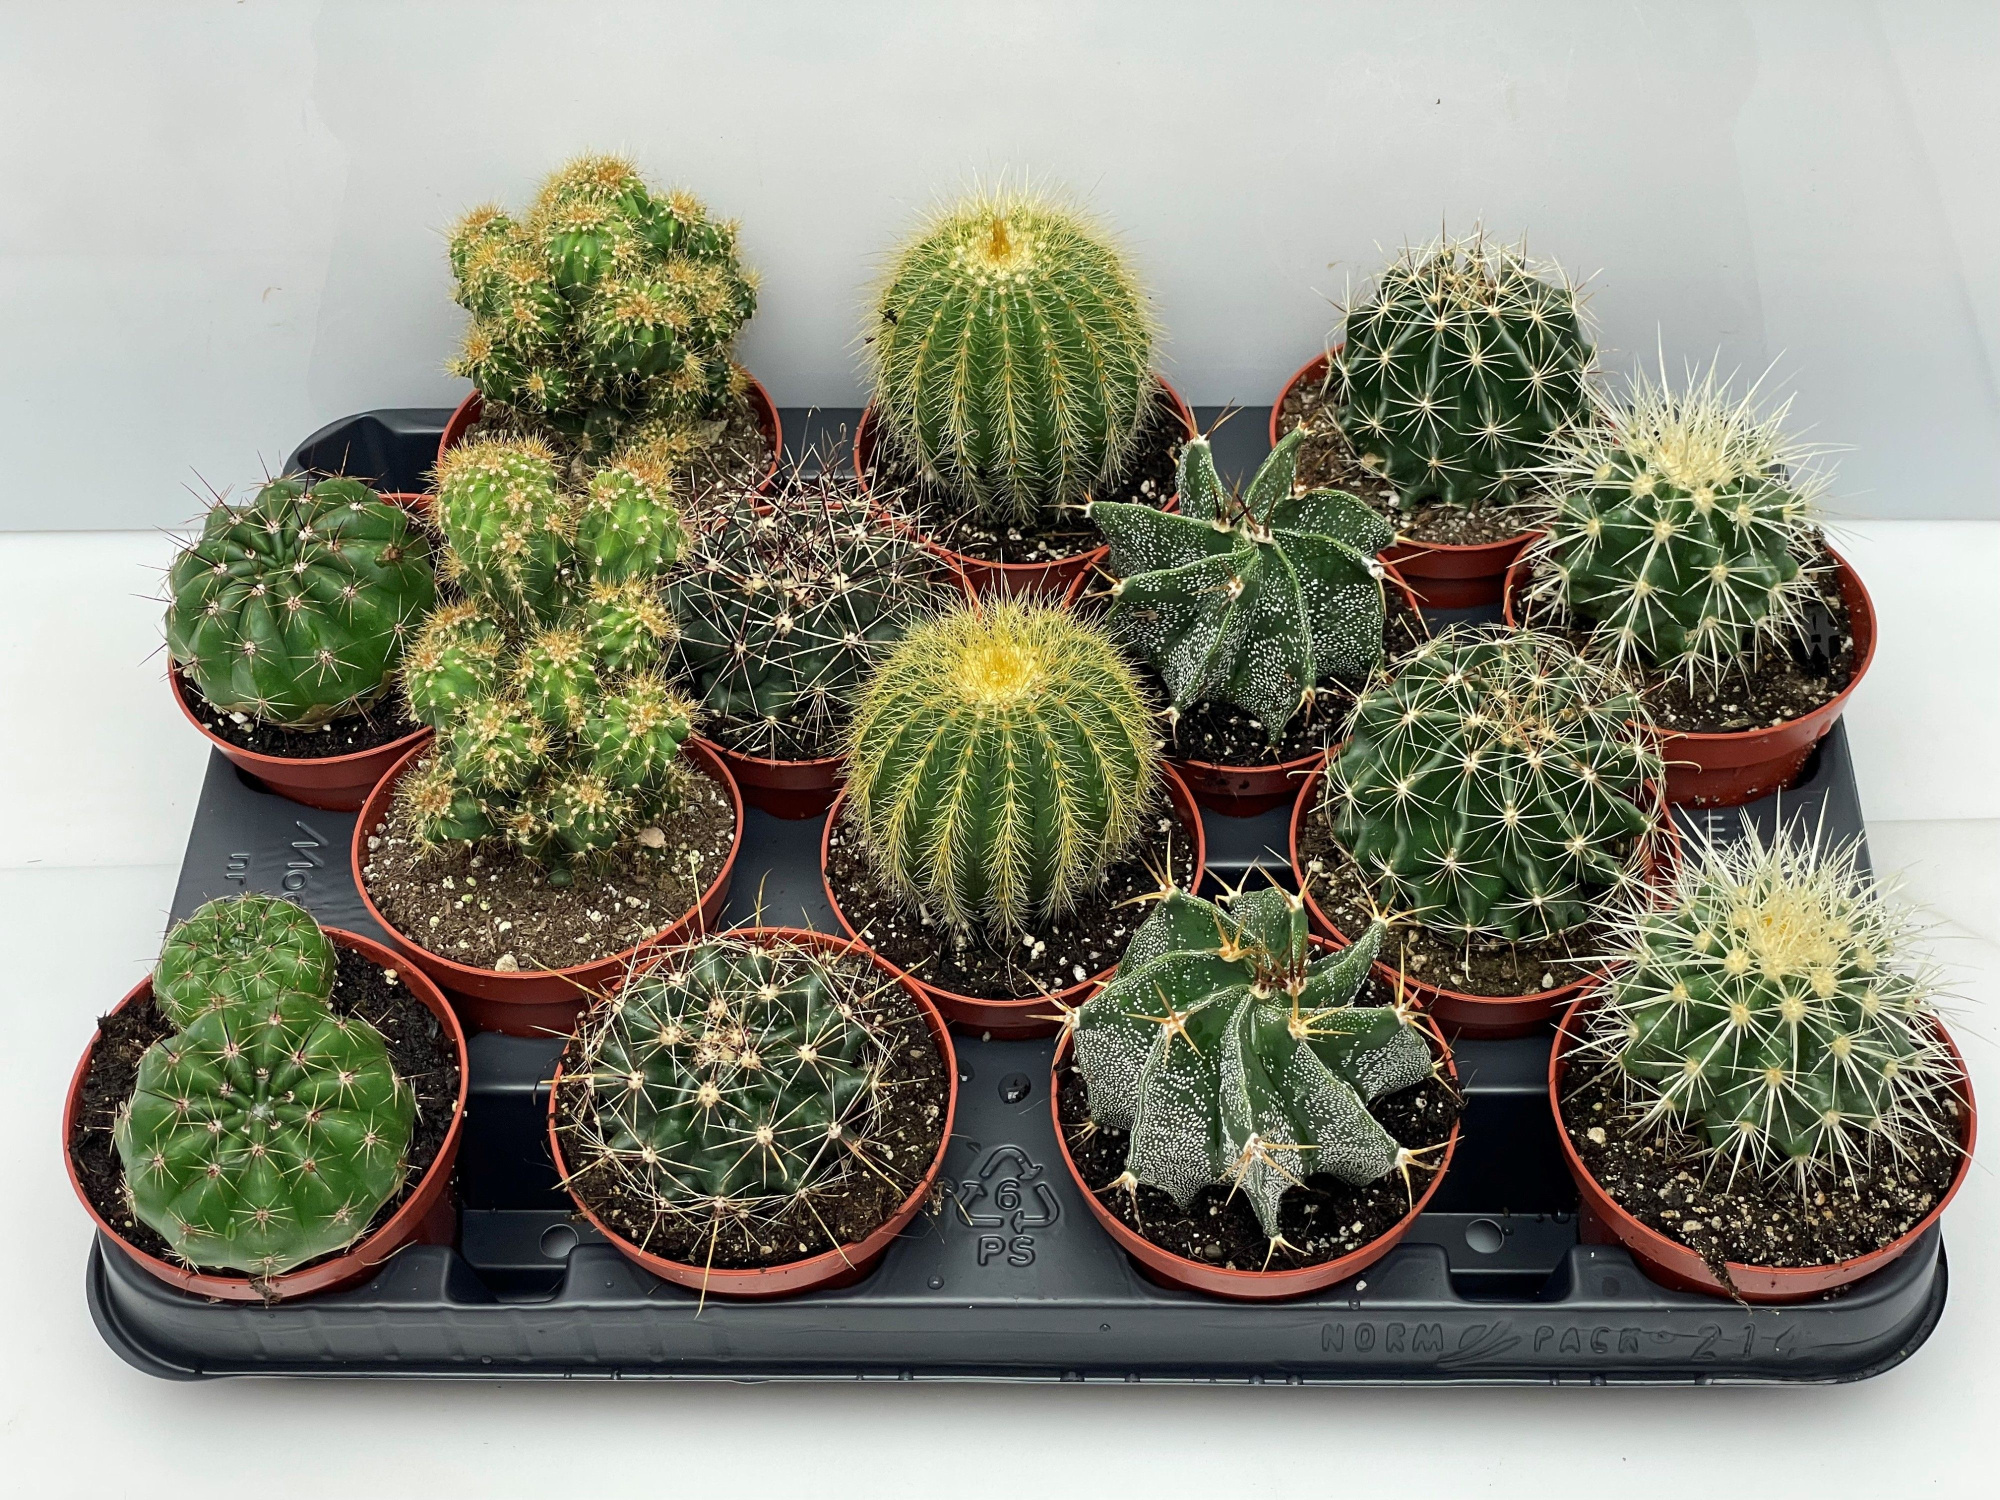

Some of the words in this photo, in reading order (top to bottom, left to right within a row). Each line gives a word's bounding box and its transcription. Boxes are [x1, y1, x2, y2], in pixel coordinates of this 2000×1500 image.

[995, 1177, 1021, 1211] 6
[977, 1233, 1036, 1267] PS
[1320, 1322, 1445, 1354] NORM
[1533, 1324, 1642, 1354] PACK
